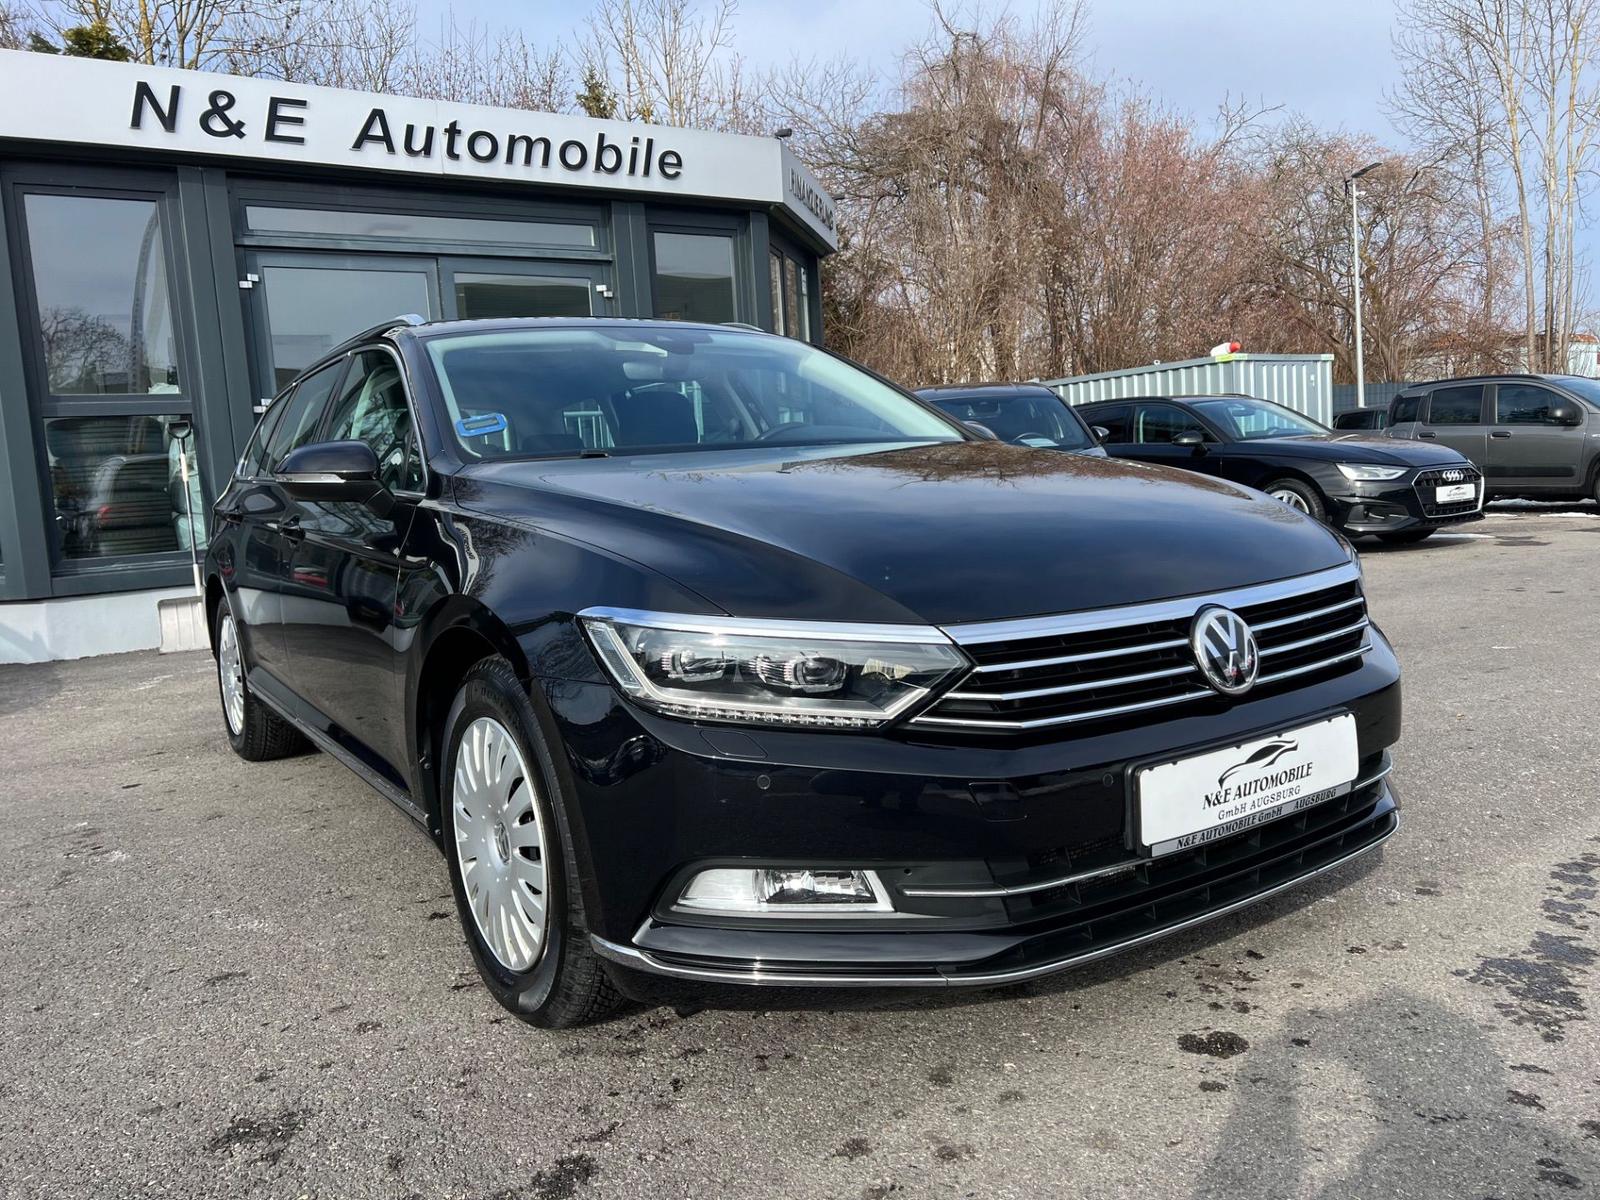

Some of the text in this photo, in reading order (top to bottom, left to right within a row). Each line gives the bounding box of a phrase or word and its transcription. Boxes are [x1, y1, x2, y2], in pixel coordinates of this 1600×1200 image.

[350, 108, 683, 180] Automobile
[1202, 762, 1313, 810] N&E AUTOMOBILE
[1218, 785, 1301, 820] GmbH AUGSBURG
[1176, 788, 1337, 849] N&E AUTOMOBILE GmbH AUGSBURG
